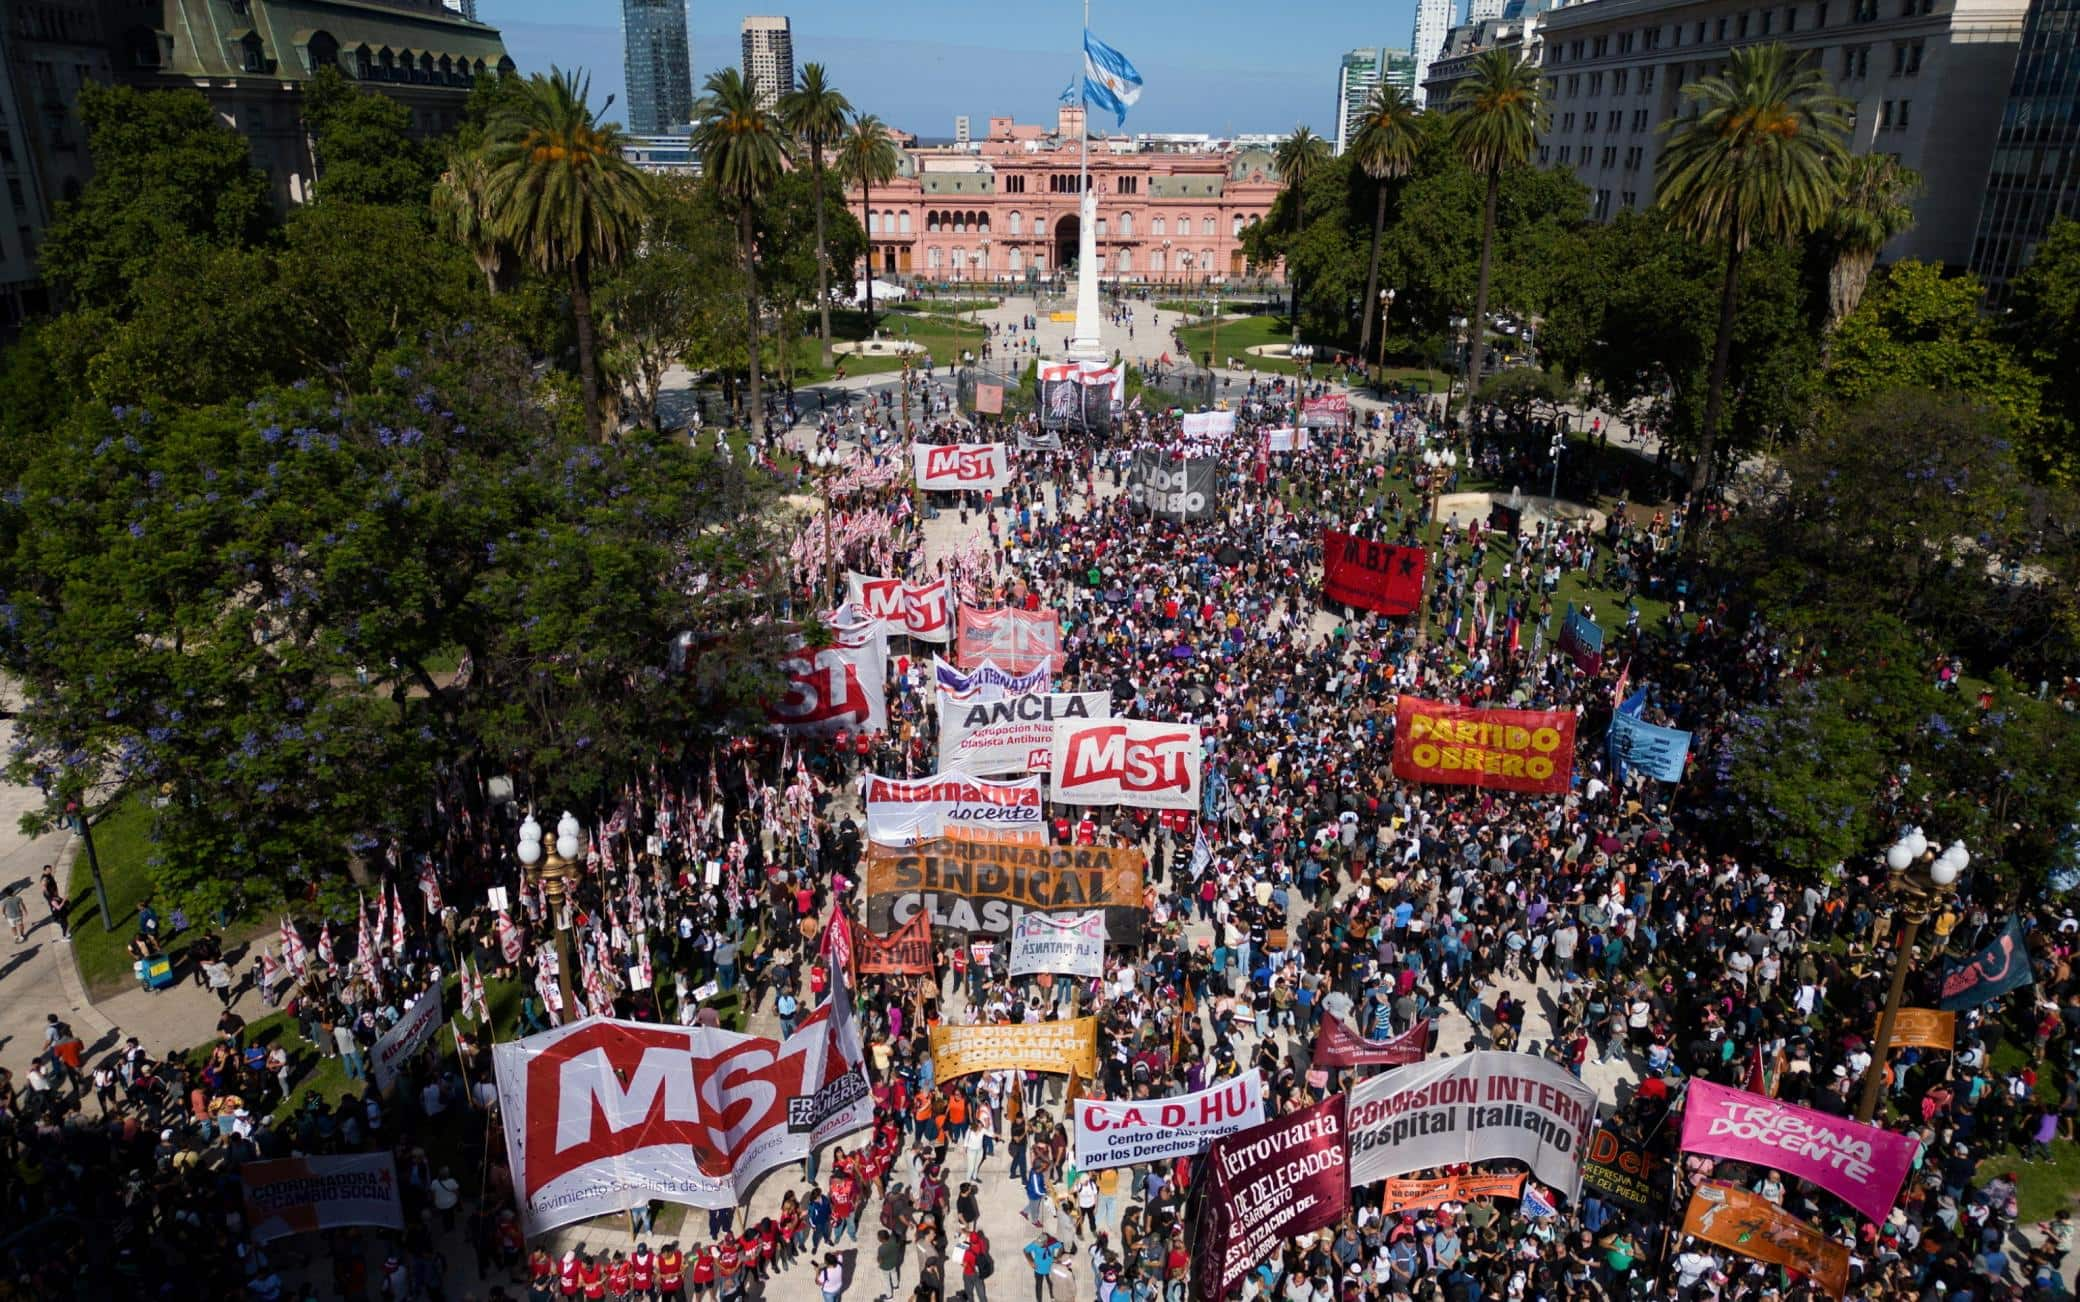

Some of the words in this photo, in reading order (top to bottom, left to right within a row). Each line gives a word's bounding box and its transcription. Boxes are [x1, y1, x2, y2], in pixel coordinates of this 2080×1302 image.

[930, 449, 994, 481] MST
[868, 586, 947, 630] MST
[963, 692, 1089, 728] ANCLA
[1410, 713, 1561, 751] PARTIDO
[1072, 733, 1189, 786] MST
[1412, 743, 1554, 780] OBRERO
[867, 778, 1041, 807] Alternativa
[949, 802, 1039, 821] docente
[900, 841, 1112, 868] ORDINADORA
[895, 857, 1112, 904] SINDICAL
[555, 1020, 831, 1155] MST
[1349, 1073, 1479, 1131] COMISIÓN
[1107, 1131, 1153, 1146] Centro
[1160, 1129, 1173, 1139] de
[1221, 1112, 1340, 1181] ferroviaria
[1350, 1106, 1456, 1157] Hospital
[1467, 1103, 1572, 1153] Italiano
[1708, 1117, 1875, 1185] DOCENTE
[1720, 1100, 1874, 1162] TRIBUNA
[1085, 1151, 1109, 1166] por
[1110, 1146, 1131, 1160] los
[1133, 1138, 1196, 1158] Derechos
[341, 1184, 392, 1201] SOCIAL
[527, 1183, 609, 1218] Movimiento
[680, 1179, 698, 1192] de
[1233, 1188, 1253, 1219] DE
[1250, 1146, 1344, 1206] DELEGADOS
[1243, 1186, 1293, 1229] SARMIENTO
[1224, 1204, 1296, 1267] ESTATIZACION
[1296, 1193, 1319, 1214] DEL
